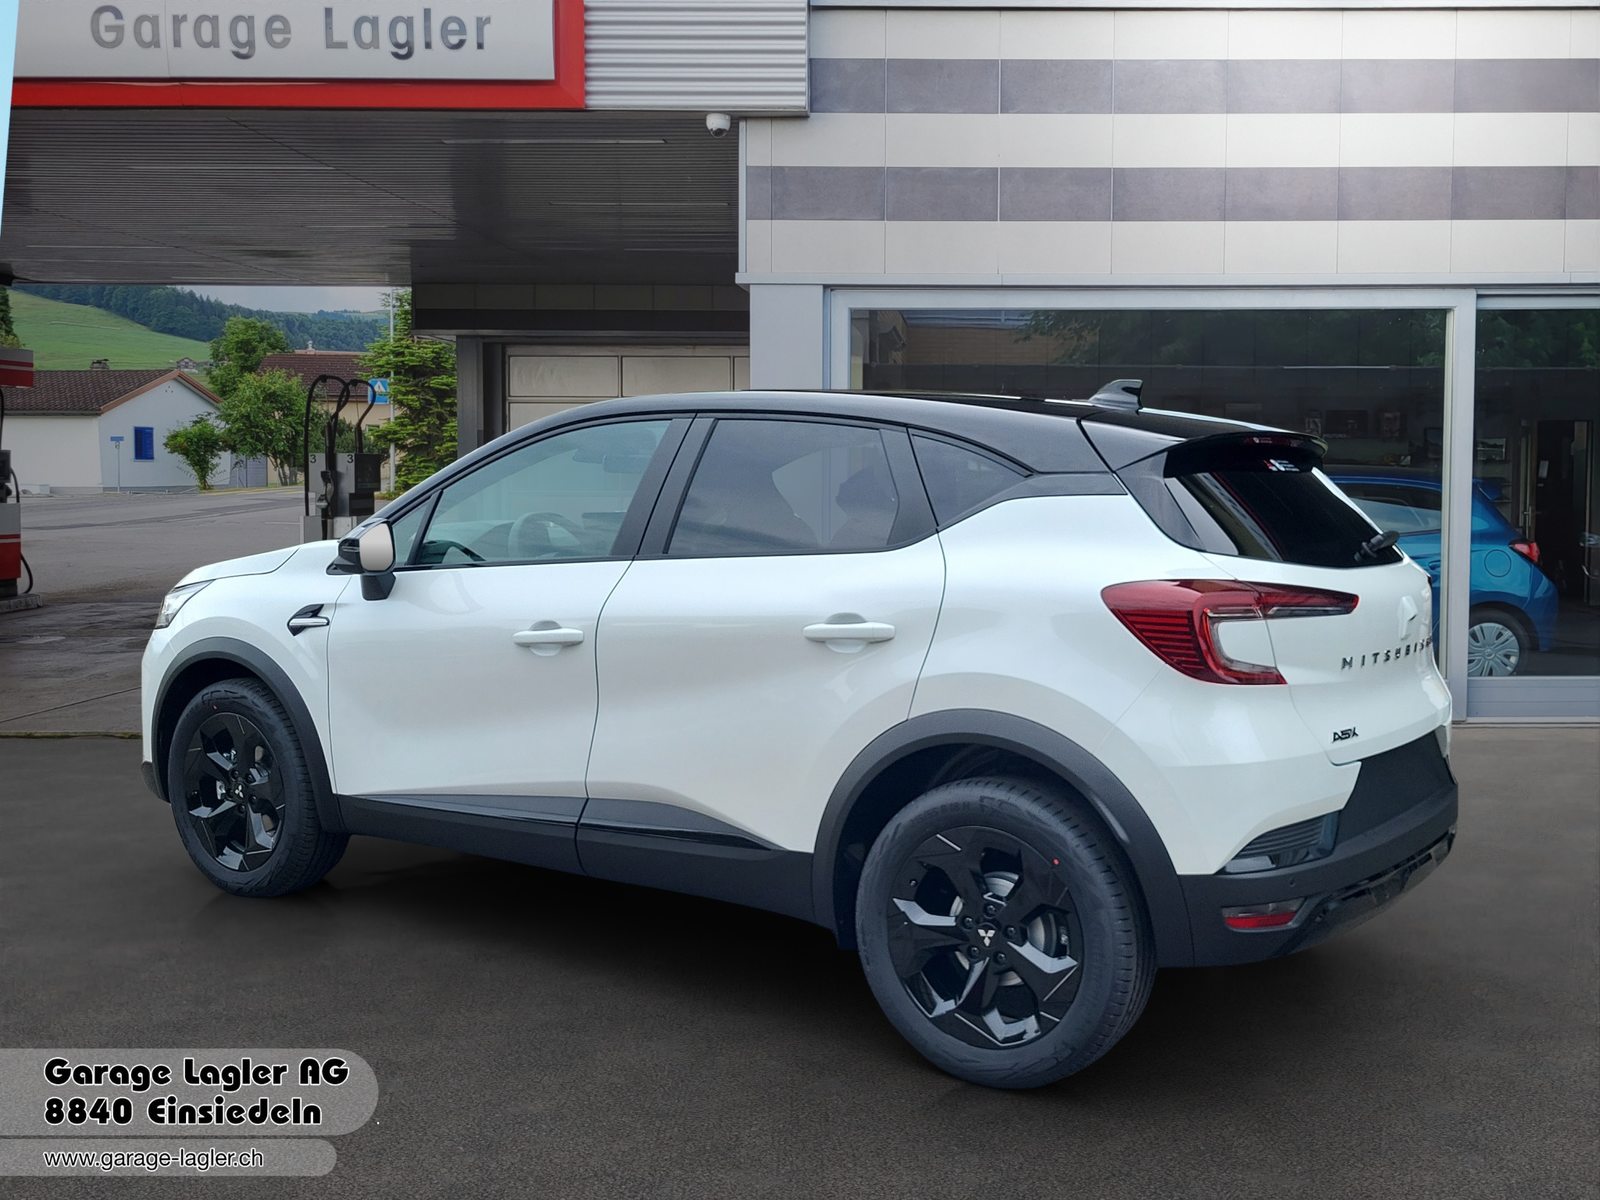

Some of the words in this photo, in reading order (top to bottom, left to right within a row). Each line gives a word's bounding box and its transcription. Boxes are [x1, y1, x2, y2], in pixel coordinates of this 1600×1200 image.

[89, 4, 292, 60] Garage
[323, 6, 492, 61] Lagler
[309, 454, 317, 464] 3
[346, 454, 354, 464] 3
[1331, 726, 1359, 743] ASX
